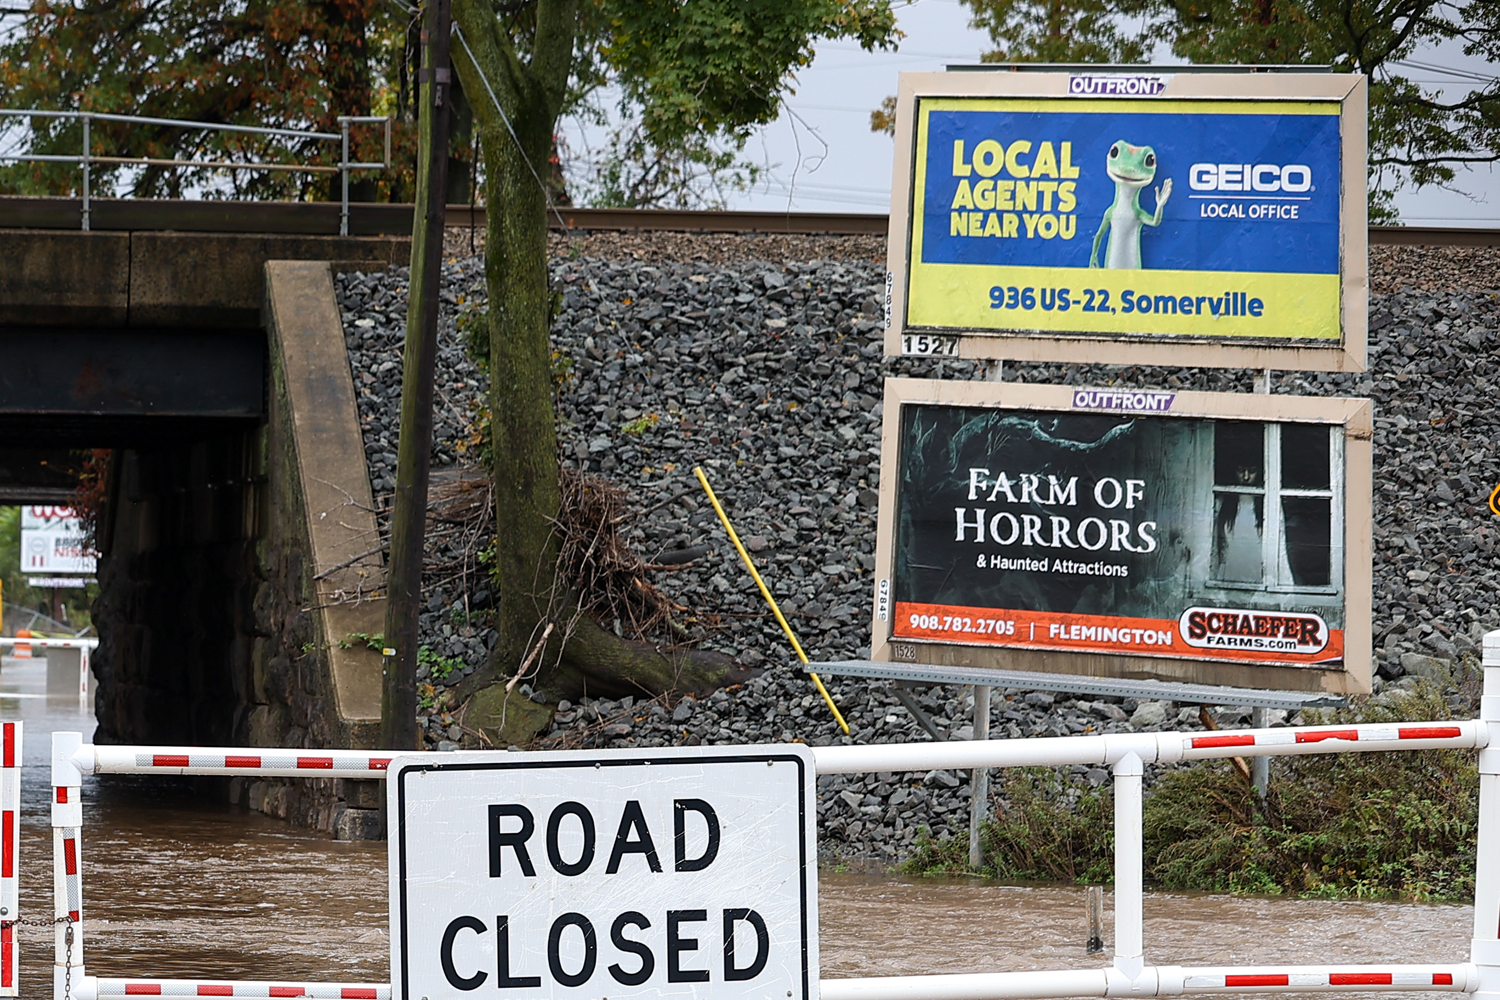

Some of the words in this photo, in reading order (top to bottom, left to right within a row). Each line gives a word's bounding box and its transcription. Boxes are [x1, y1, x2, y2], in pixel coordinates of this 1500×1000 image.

[1071, 78, 1159, 94] OUTFRONT
[952, 139, 1080, 179] LOCAL
[1189, 163, 1312, 192] GEICO
[951, 179, 1077, 212] AGENTS
[950, 212, 1020, 238] NEAR
[1022, 213, 1077, 239] YOU
[1200, 203, 1246, 218] LOCAL
[1248, 204, 1299, 219] OFFICE
[989, 286, 1036, 310] 936
[1040, 288, 1116, 315] US-22,
[1121, 289, 1264, 317] Somerville
[904, 336, 957, 354] 1527
[1075, 392, 1171, 410] OUTFRONT
[967, 468, 1079, 506] FARM
[1094, 477, 1146, 509] OF
[954, 507, 1157, 553] HORRORS
[976, 554, 987, 568] &
[990, 555, 1049, 572] Haunted
[1052, 558, 1128, 577] Attractions
[910, 614, 1015, 635] 908.782.2705
[1050, 623, 1172, 645] FLEMINGTON
[1188, 611, 1322, 646] SCHAEFER
[1207, 636, 1297, 650] FARMS.com
[895, 645, 915, 659] 1528
[487, 798, 721, 878] ROAD
[440, 908, 770, 992] CLOSED
